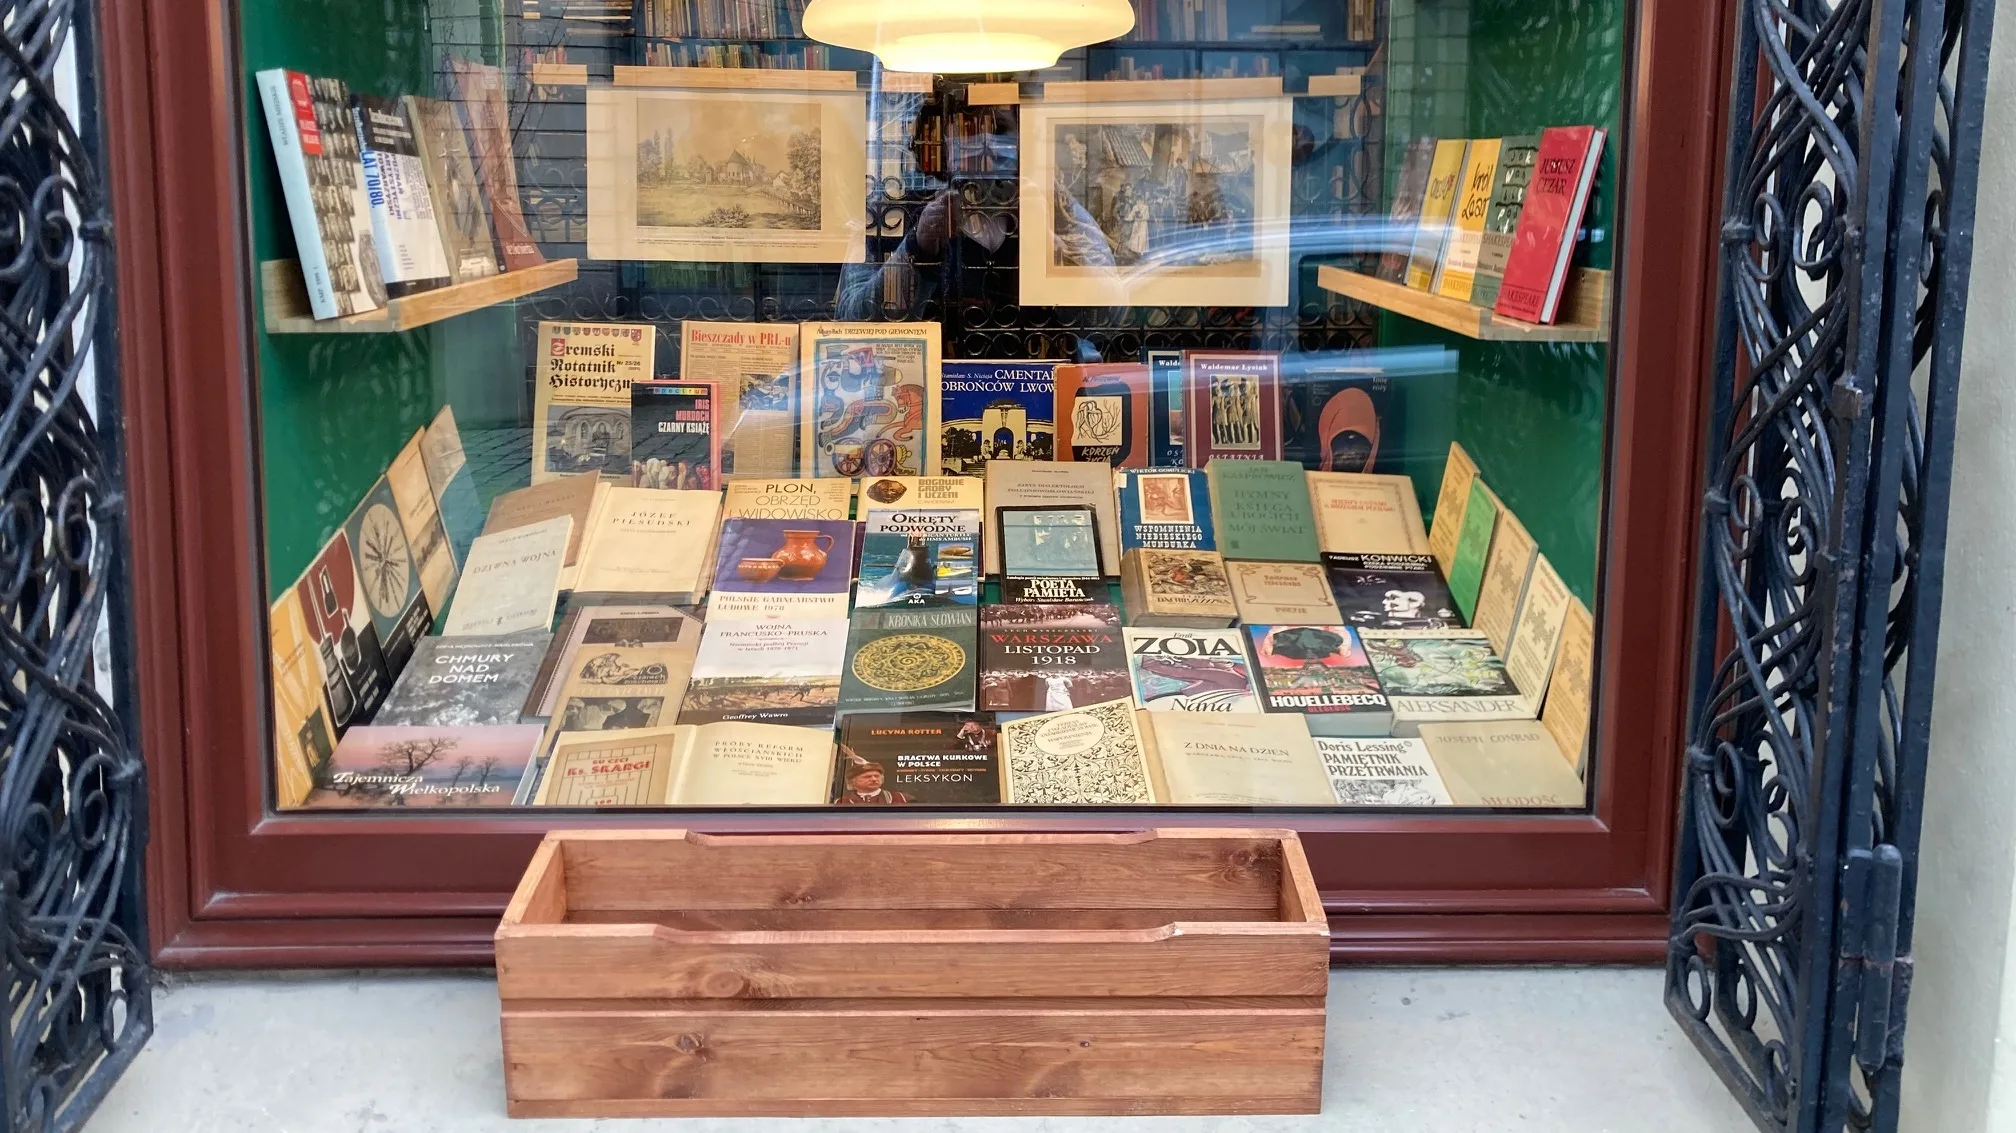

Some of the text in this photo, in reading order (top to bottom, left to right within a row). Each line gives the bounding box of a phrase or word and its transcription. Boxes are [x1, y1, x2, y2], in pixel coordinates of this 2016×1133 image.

[362, 152, 378, 168] LAT
[692, 330, 744, 344] Bieszczady
[550, 359, 615, 373] Notatnik
[549, 374, 634, 392] Historyczn
[942, 380, 1014, 392] OBROŃCÓW
[695, 399, 710, 410] IRIS
[676, 410, 710, 421] MURDOCH
[658, 421, 685, 432] CZARNY
[756, 495, 821, 507] OBRZĘD
[739, 508, 842, 520] WIDOWISKO
[522, 550, 556, 562] WOJNA
[1360, 554, 1432, 563] KONWICKI
[1031, 580, 1076, 588] POETA
[889, 615, 927, 627] KRONIKA
[991, 635, 1112, 643] WARSZAWA
[1005, 646, 1100, 654] LISTOPAD
[435, 654, 514, 664] CHMURY
[1032, 656, 1076, 665] 1918
[449, 664, 490, 673] NAD
[428, 674, 498, 684] DOMEM
[1171, 698, 1232, 712] Nana
[1270, 694, 1387, 708] HOUELLEBECQ
[1397, 700, 1524, 713] ALEKSANDER
[1490, 734, 1540, 743] CONRAD
[758, 744, 803, 752] REFORM
[1196, 743, 1226, 751] DNIA
[1318, 741, 1406, 754] Doris Lessing
[592, 760, 651, 774] SKARGI
[1323, 754, 1401, 768] PAMIĘTNIK
[1328, 766, 1428, 777] PRZETRWANIA
[333, 772, 423, 784] Tajemnicza
[897, 774, 972, 783] LEKSYKON
[389, 784, 500, 796] Wielkopolska
